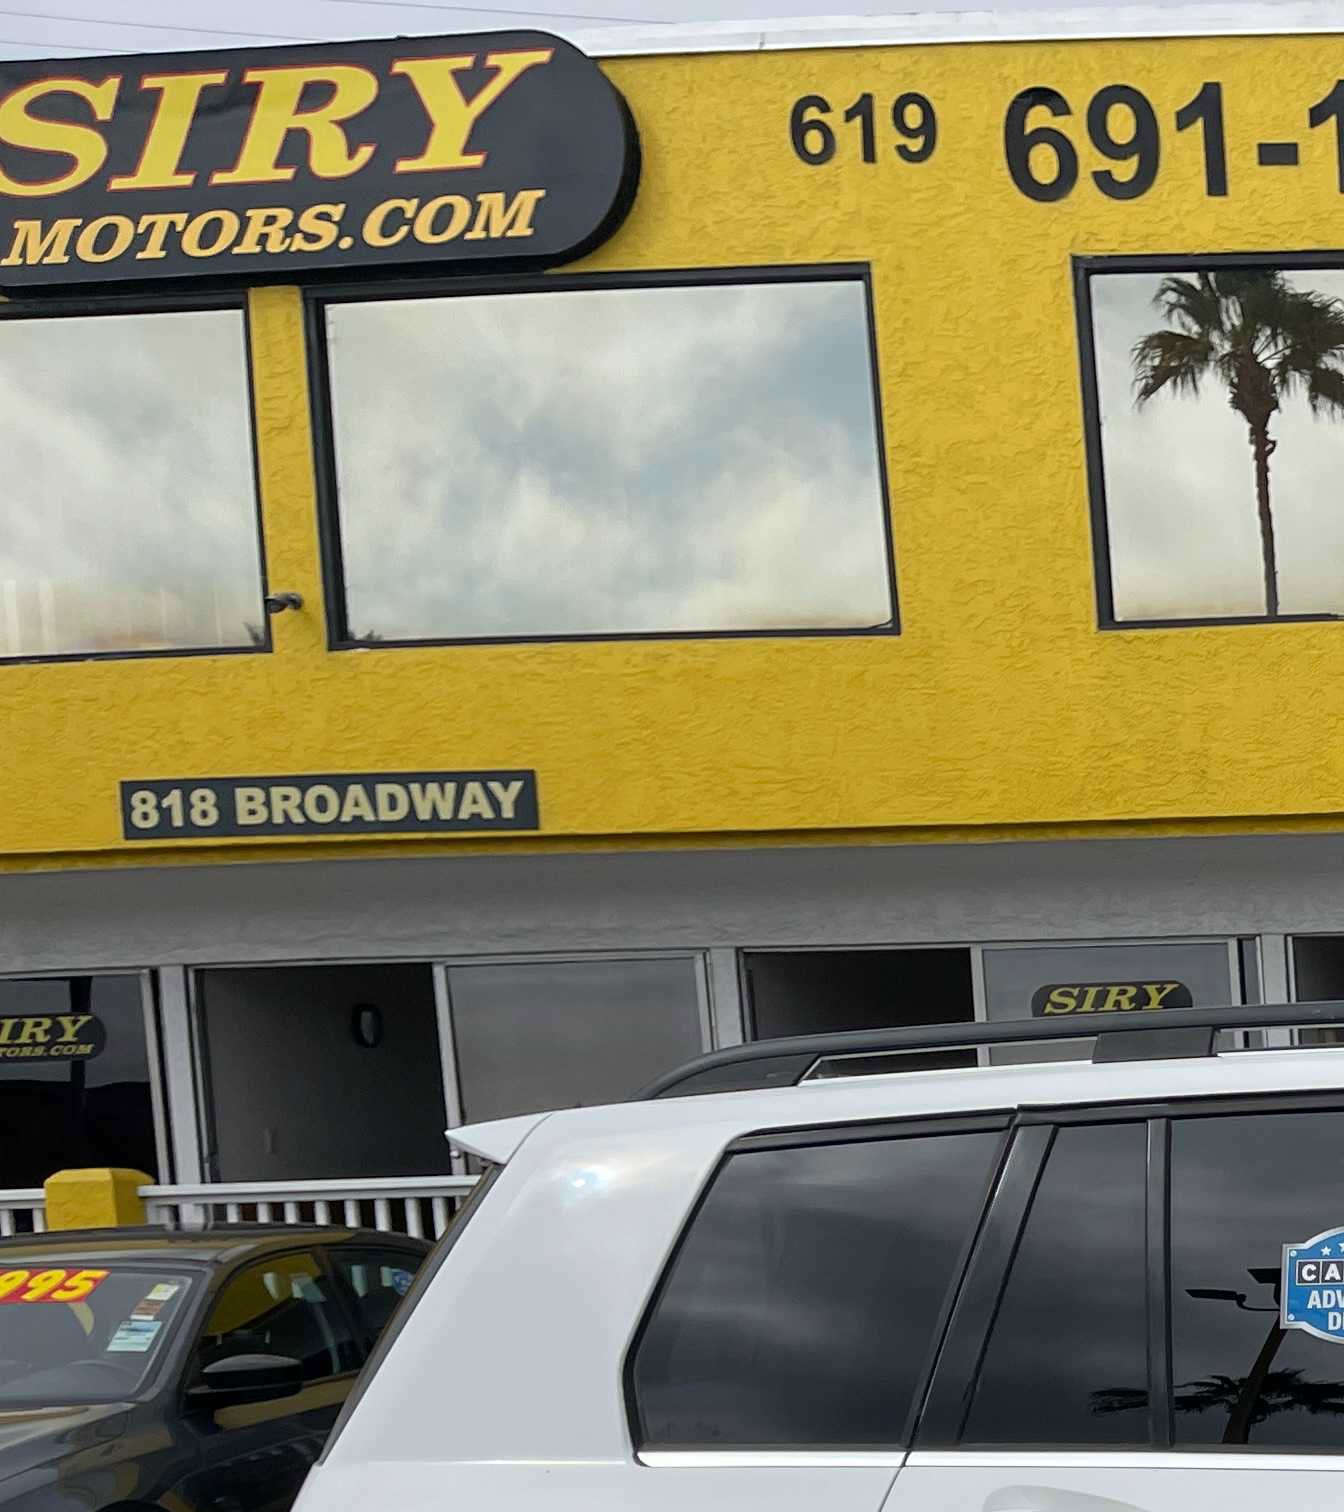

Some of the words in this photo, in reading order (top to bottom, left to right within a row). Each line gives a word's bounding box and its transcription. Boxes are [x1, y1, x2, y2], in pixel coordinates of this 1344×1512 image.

[0, 47, 555, 198] SIRY
[789, 91, 939, 167] 619
[1, 188, 546, 267] MOTORS.COM
[130, 788, 220, 828] 818
[235, 780, 523, 826] BROADWAY
[1044, 983, 1180, 1014] SIRY
